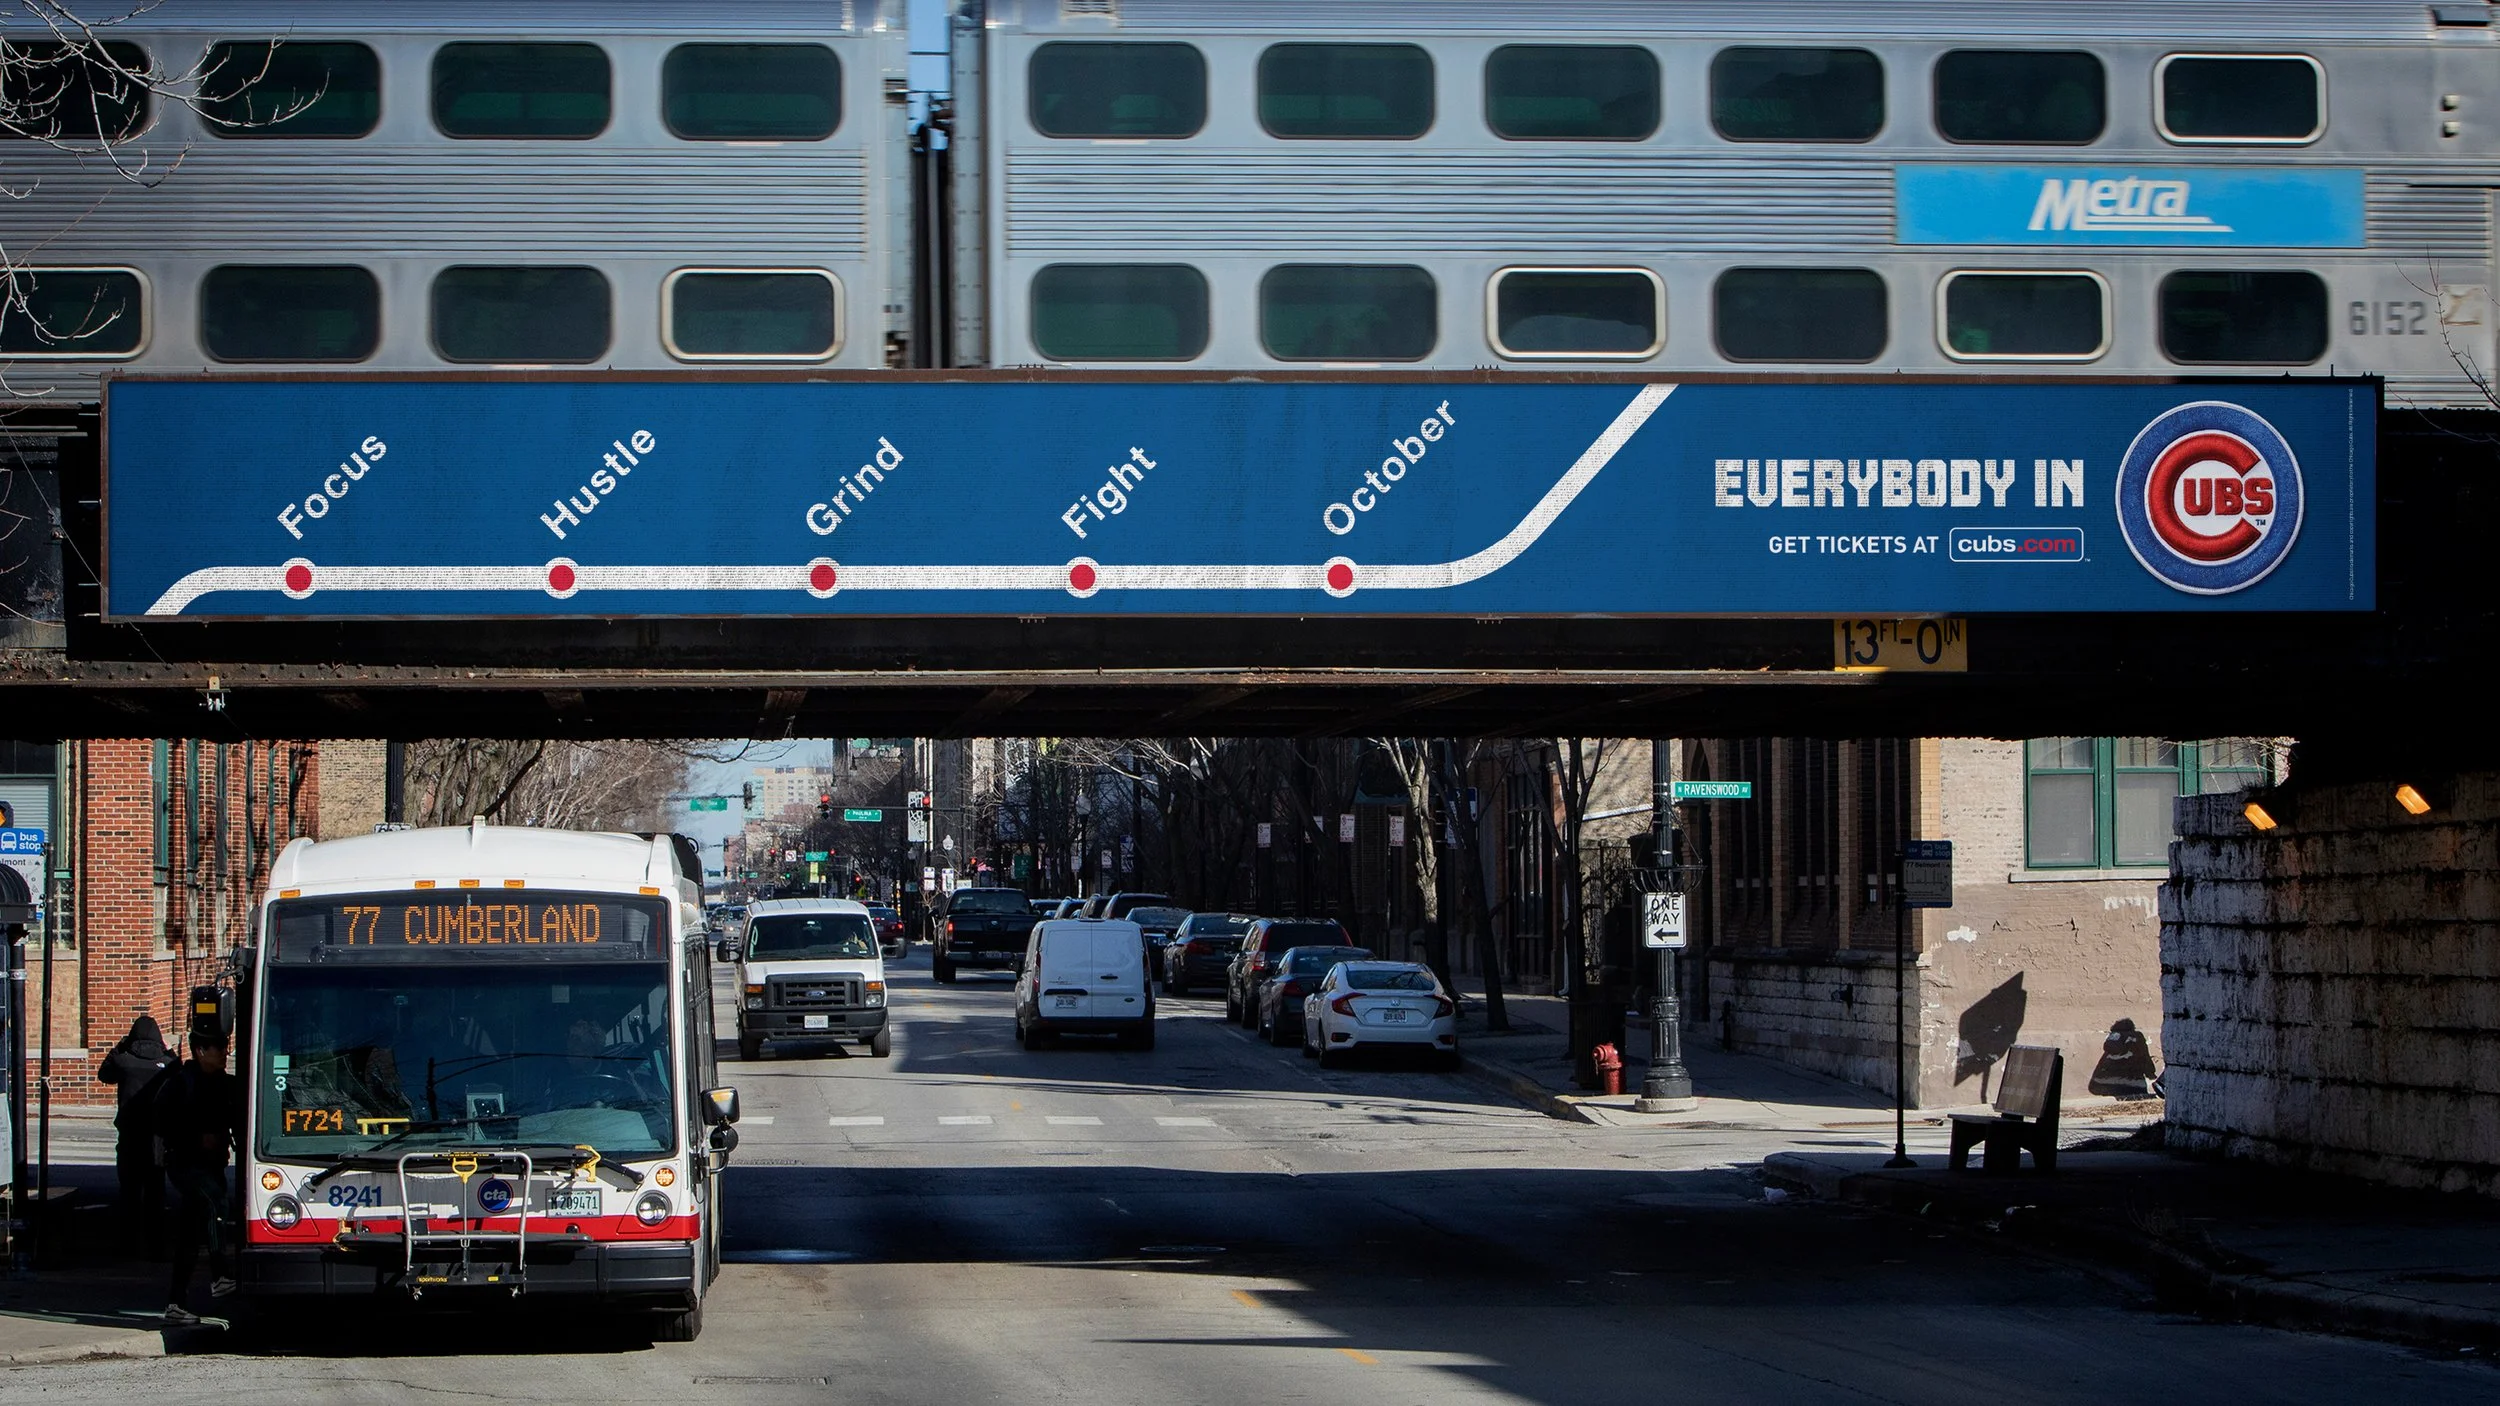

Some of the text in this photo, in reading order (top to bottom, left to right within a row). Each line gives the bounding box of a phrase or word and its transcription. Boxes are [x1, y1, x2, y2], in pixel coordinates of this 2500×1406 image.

[2027, 175, 2193, 231] Metra
[2350, 300, 2427, 336] 6152
[1323, 400, 1457, 537] October
[1715, 459, 2084, 507] EVERYBODY IN
[277, 435, 388, 541] Focus
[540, 429, 656, 540] Hustle
[806, 437, 905, 536] Grind
[1061, 446, 1158, 540] Fight
[2148, 433, 2273, 561] CUBS
[1769, 534, 2076, 554] GET TICKETS AT cubs.com
[1684, 783, 1740, 796] RAVENSWOOD
[19, 841, 41, 852] stop
[20, 831, 38, 841] bus
[1651, 898, 1680, 910] ONE
[343, 904, 600, 945] 77 CUMBERLAND
[1651, 913, 1680, 925] WAY
[275, 1076, 287, 1091] 3
[285, 1109, 343, 1132] F724
[328, 1185, 382, 1207] 8241
[483, 1189, 509, 1201] cta
